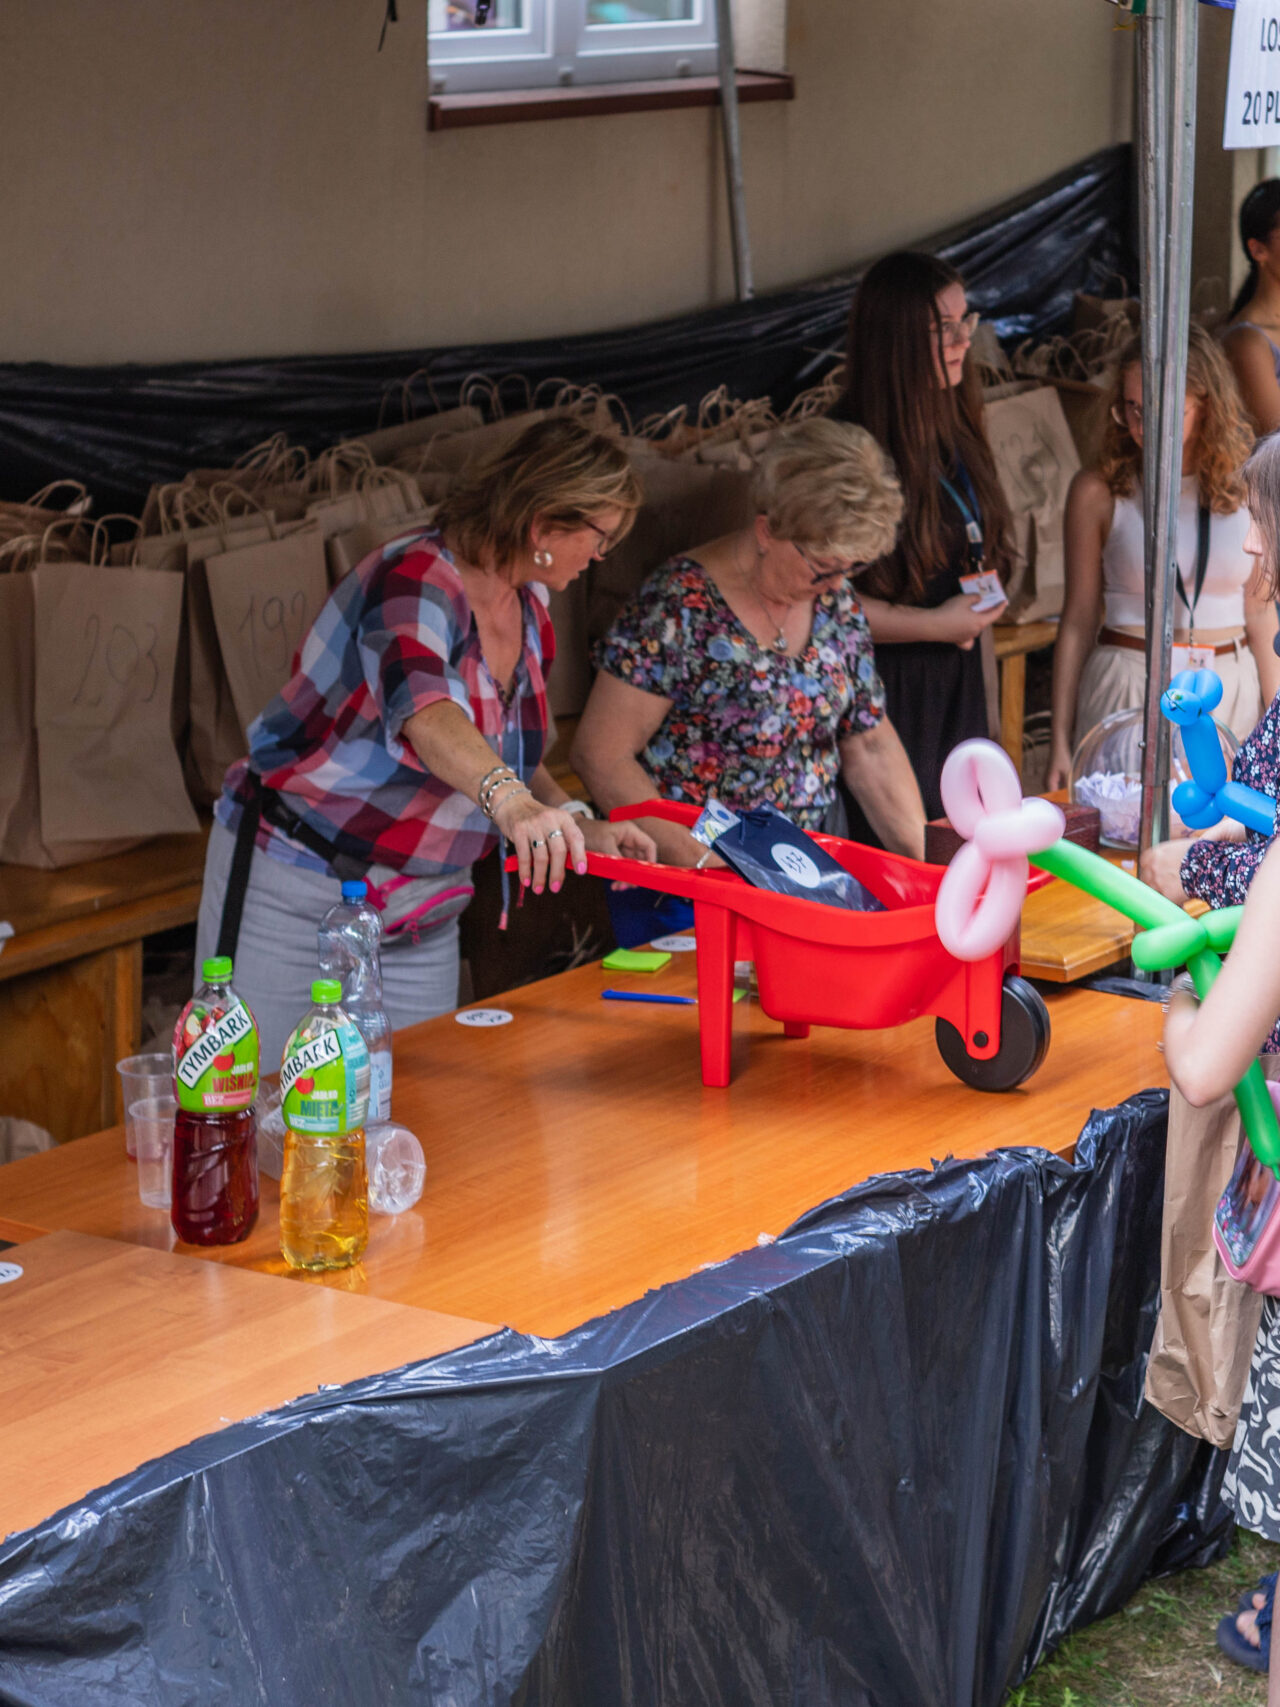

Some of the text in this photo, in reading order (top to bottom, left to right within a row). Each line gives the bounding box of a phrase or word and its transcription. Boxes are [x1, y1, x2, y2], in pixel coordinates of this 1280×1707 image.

[1242, 91, 1261, 125] 20
[181, 1009, 249, 1080] TYMBARK
[280, 1035, 337, 1097] YMBARK
